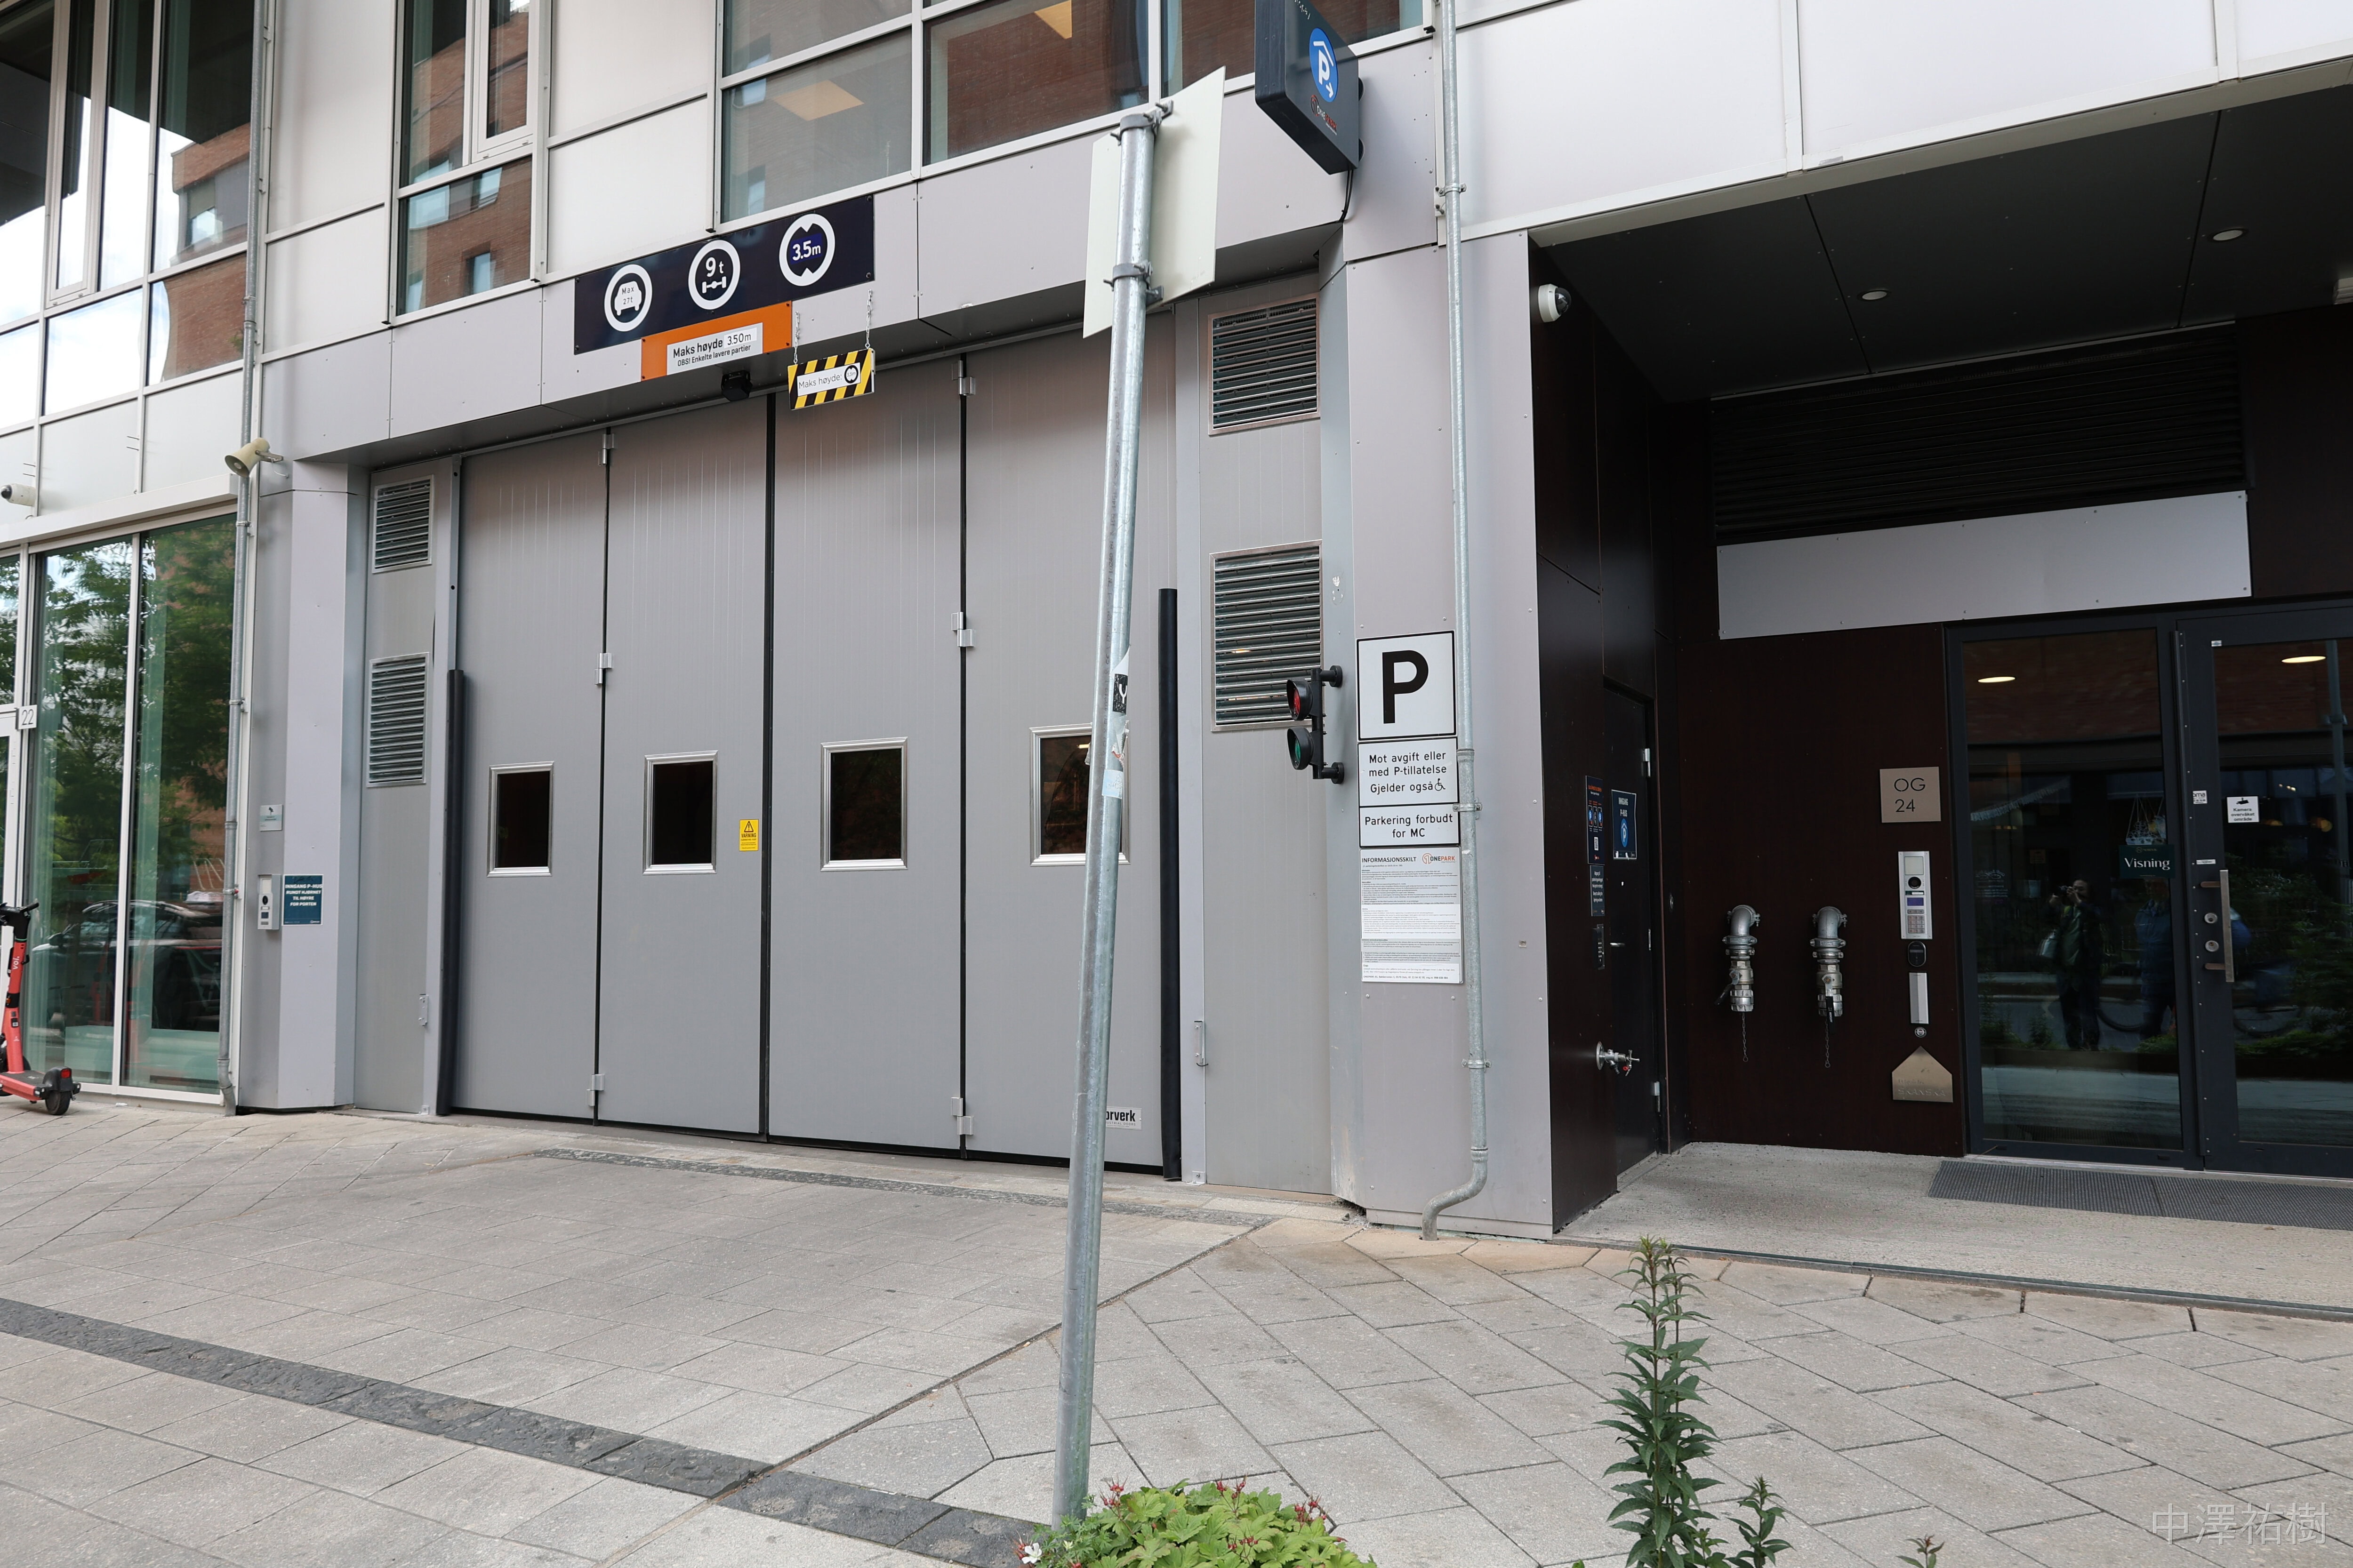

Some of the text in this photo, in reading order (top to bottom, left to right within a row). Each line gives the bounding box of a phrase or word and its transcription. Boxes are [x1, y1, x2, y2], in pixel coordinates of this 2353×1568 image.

[792, 240, 821, 261] 3.5m
[706, 257, 716, 277] 9
[622, 287, 635, 295] Max
[623, 296, 633, 305] 27t
[673, 333, 752, 359] Maks høyde 3.50m
[677, 345, 752, 367] OBS! Enkelte lavere partier
[798, 379, 817, 389] Maks
[819, 374, 843, 385] høyde:
[1382, 650, 1429, 724] P
[22, 709, 34, 725] 22
[1369, 751, 1446, 764] Mot avgift eller
[1369, 765, 1447, 776] med P-tillatelse
[1370, 781, 1433, 795] Gjelder også
[1894, 777, 1926, 792] OG
[1895, 799, 1915, 812] 24
[1365, 813, 1453, 826] Parkering forbudt
[1392, 828, 1425, 838] for MC
[2124, 857, 2171, 871] Visning
[1106, 1110, 1136, 1122] orverk
